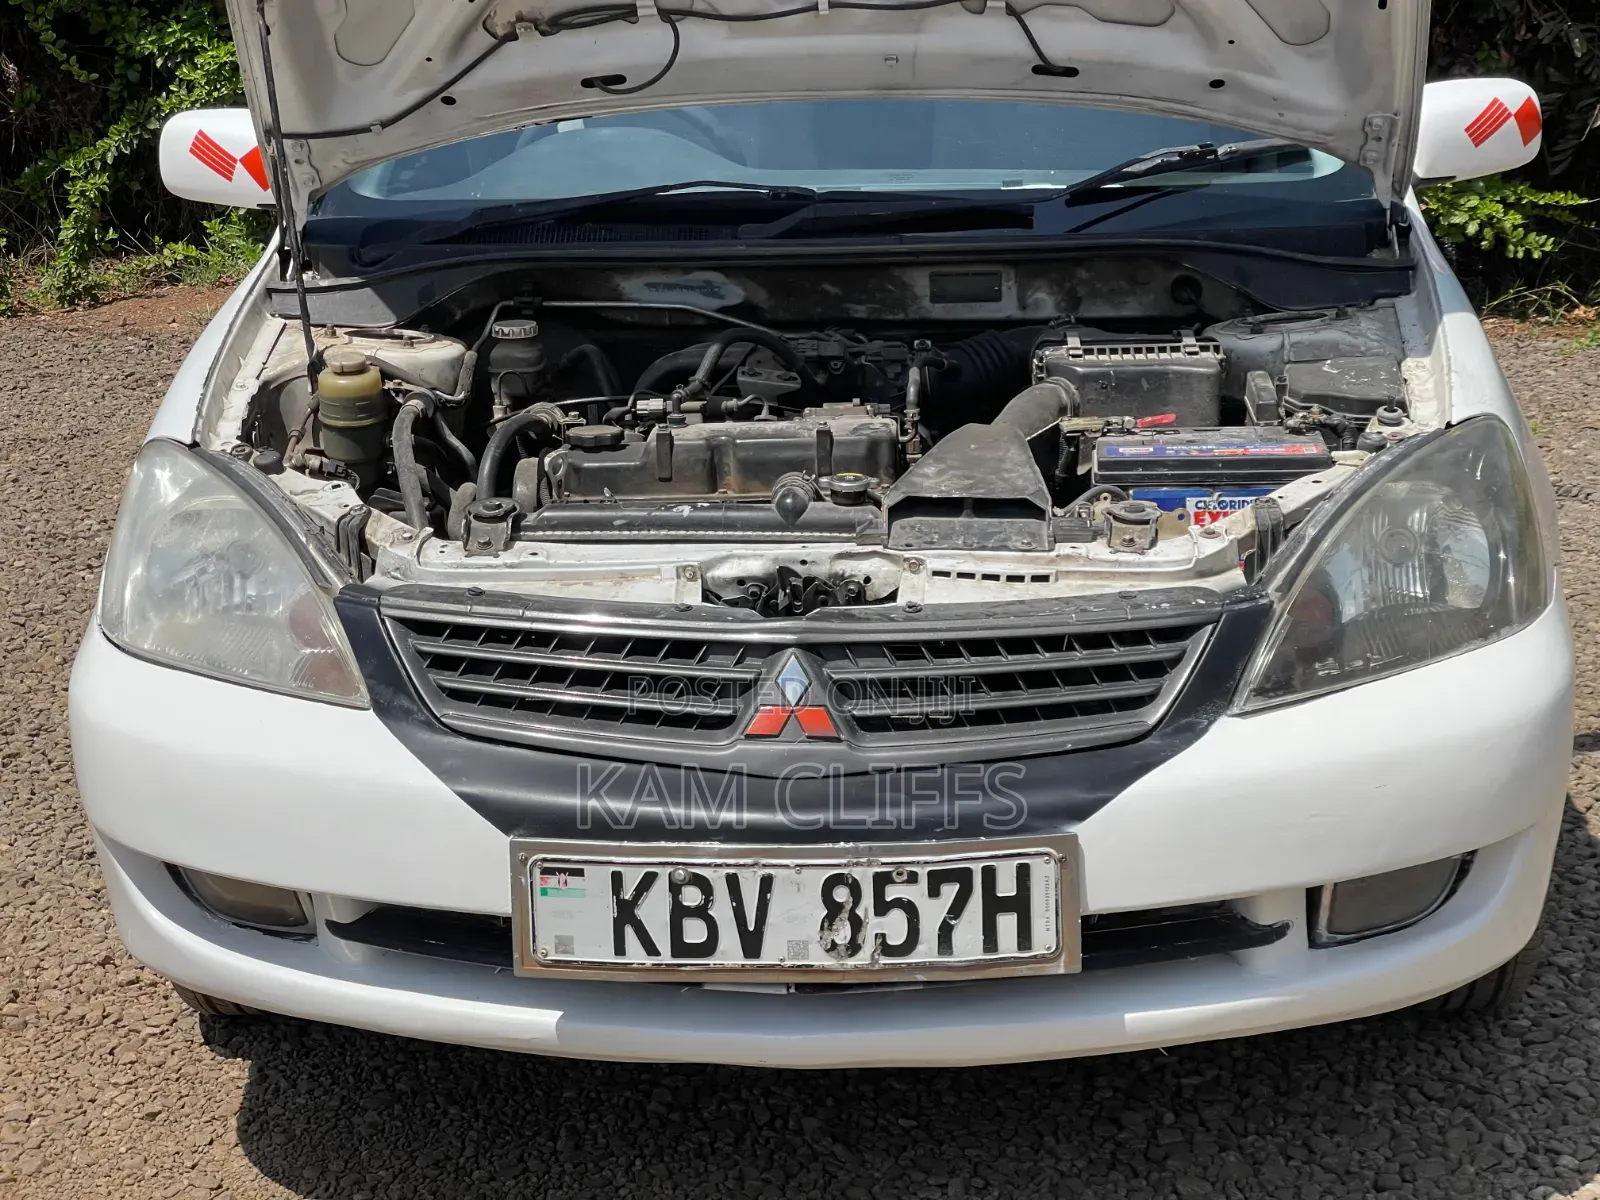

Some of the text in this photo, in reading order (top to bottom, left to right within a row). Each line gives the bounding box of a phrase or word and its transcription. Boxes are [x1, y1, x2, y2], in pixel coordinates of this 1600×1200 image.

[1195, 499, 1253, 510] CORID
[612, 862, 1034, 960] KBV 857H
